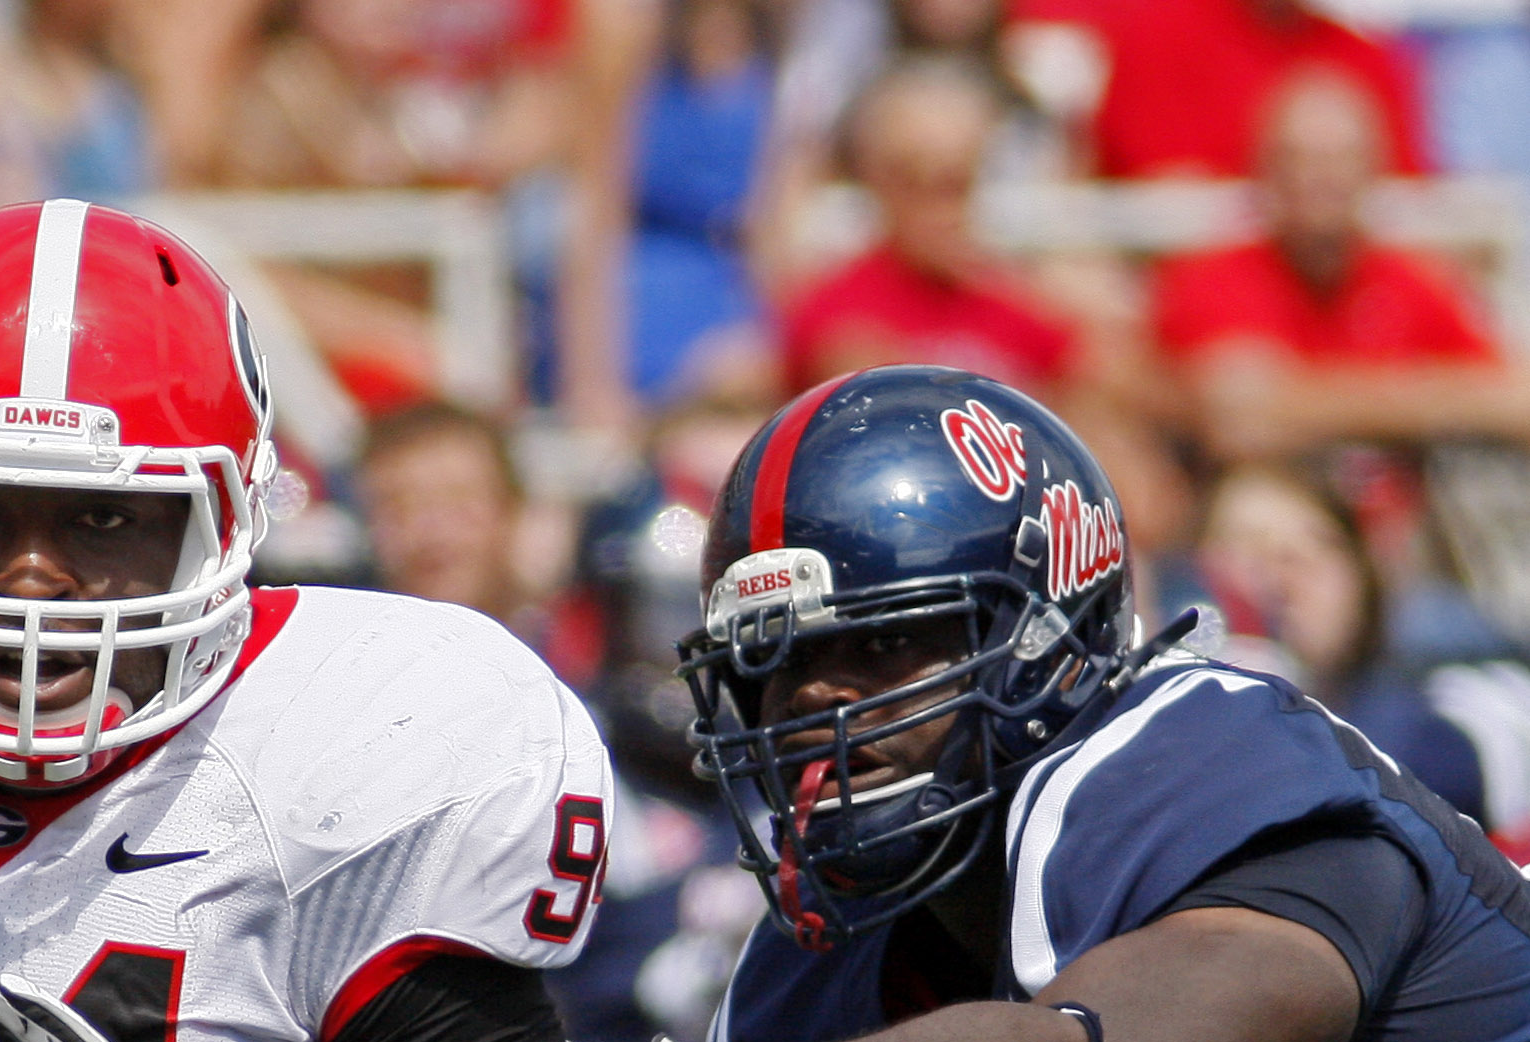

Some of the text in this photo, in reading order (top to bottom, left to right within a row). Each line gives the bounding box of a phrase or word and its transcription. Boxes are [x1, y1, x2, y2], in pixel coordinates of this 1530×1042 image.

[4, 406, 81, 429] DAWGS
[1040, 480, 1123, 602] Miss
[736, 569, 792, 598] REBS
